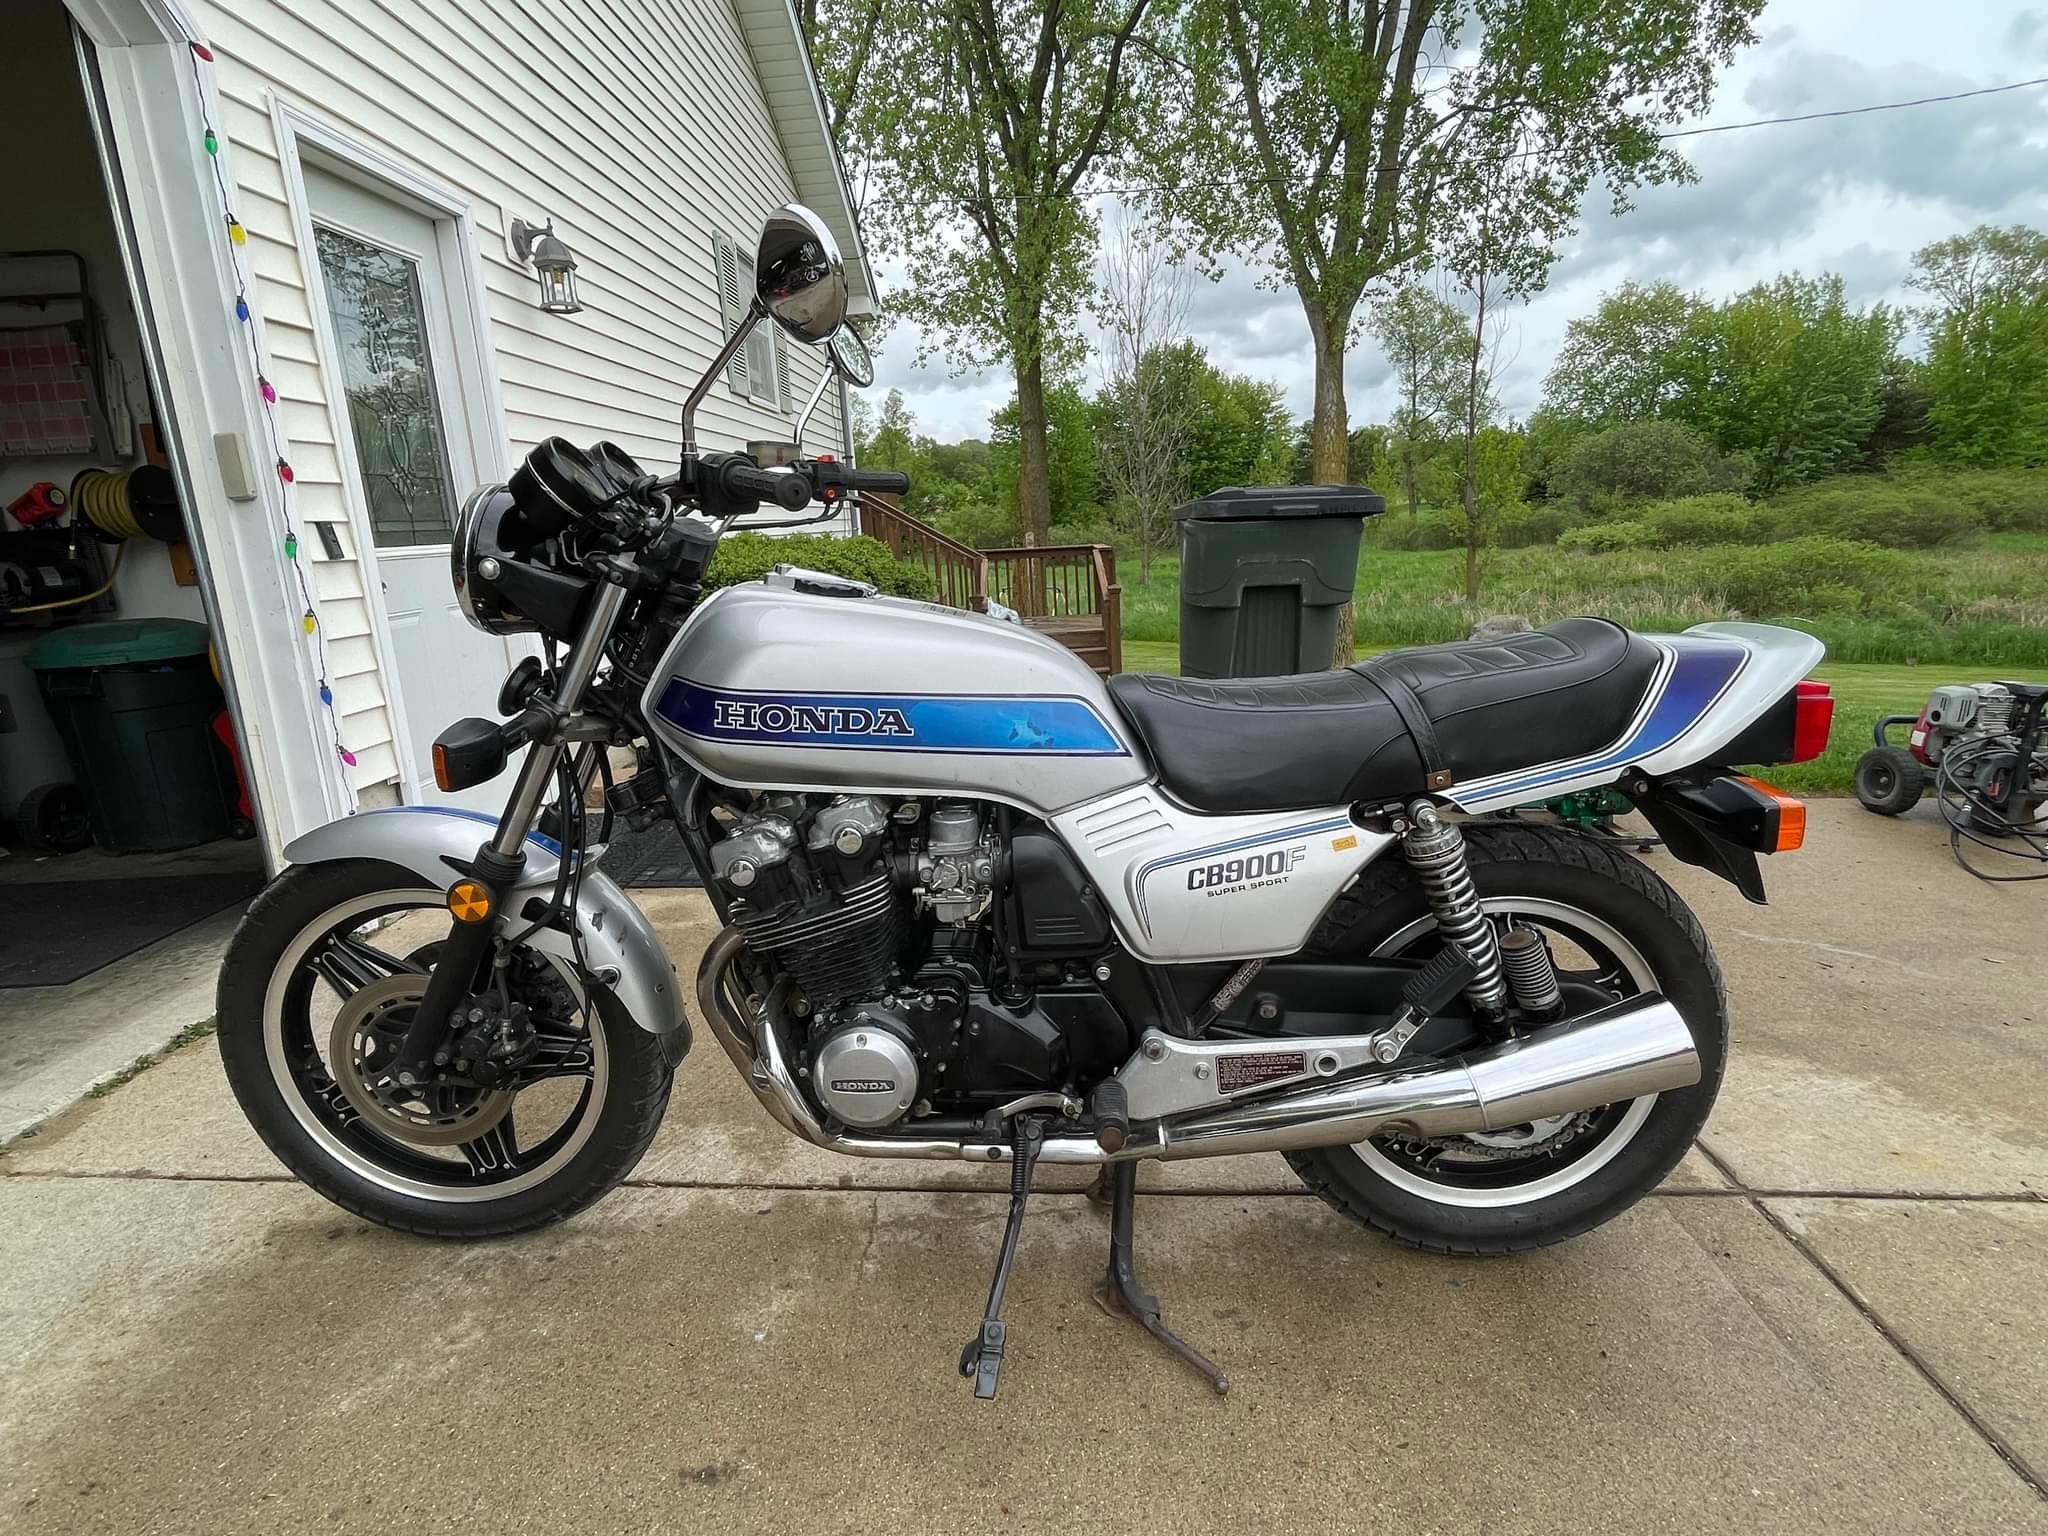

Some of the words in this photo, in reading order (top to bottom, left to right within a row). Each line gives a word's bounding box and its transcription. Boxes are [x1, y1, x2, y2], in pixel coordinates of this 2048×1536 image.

[714, 701, 914, 736] HONDA
[1187, 845, 1307, 891] CB900F
[1207, 885, 1247, 898] SUPER
[1250, 876, 1289, 890] SPORT
[835, 1082, 891, 1091] HONDA
